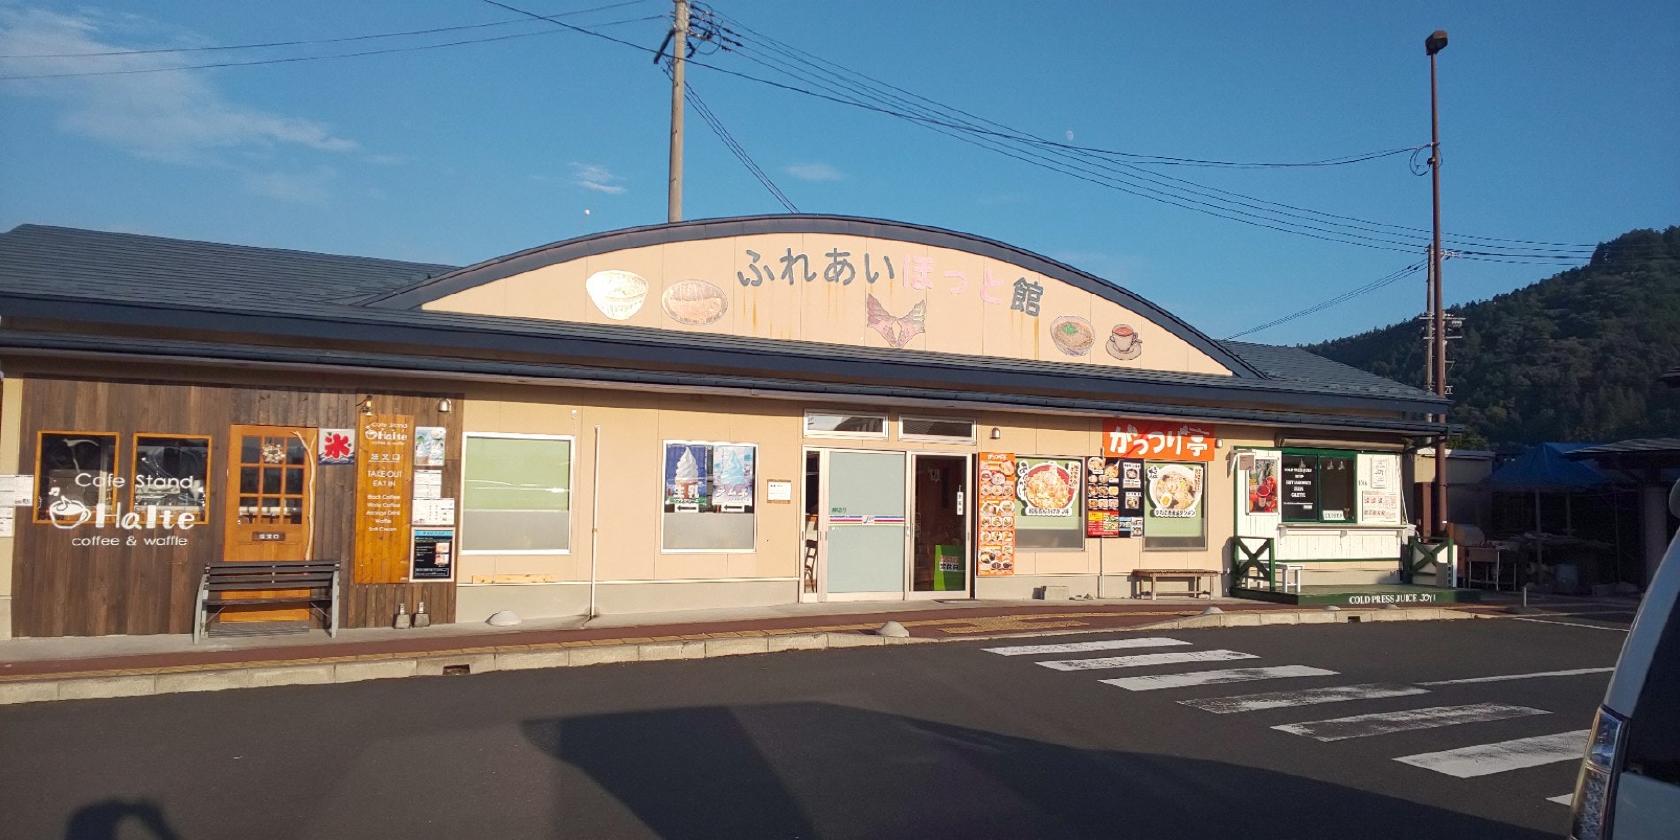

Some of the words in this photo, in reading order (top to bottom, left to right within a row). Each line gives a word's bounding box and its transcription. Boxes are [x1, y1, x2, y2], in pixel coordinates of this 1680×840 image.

[737, 247, 1044, 317] ふれあいほっと館
[324, 432, 351, 459] 氷
[1109, 424, 1208, 457] がっつり亭
[75, 473, 125, 488] Cafe
[136, 475, 194, 488] Stand
[367, 470, 386, 478] TAKE
[386, 470, 402, 478] OUT
[95, 502, 196, 530] Halte
[72, 535, 120, 546] coffee
[126, 535, 137, 546] &
[144, 535, 188, 546] waffle
[1348, 595, 1371, 605] COLD
[1371, 594, 1395, 604] PRESS
[1395, 593, 1417, 603] JUICE
